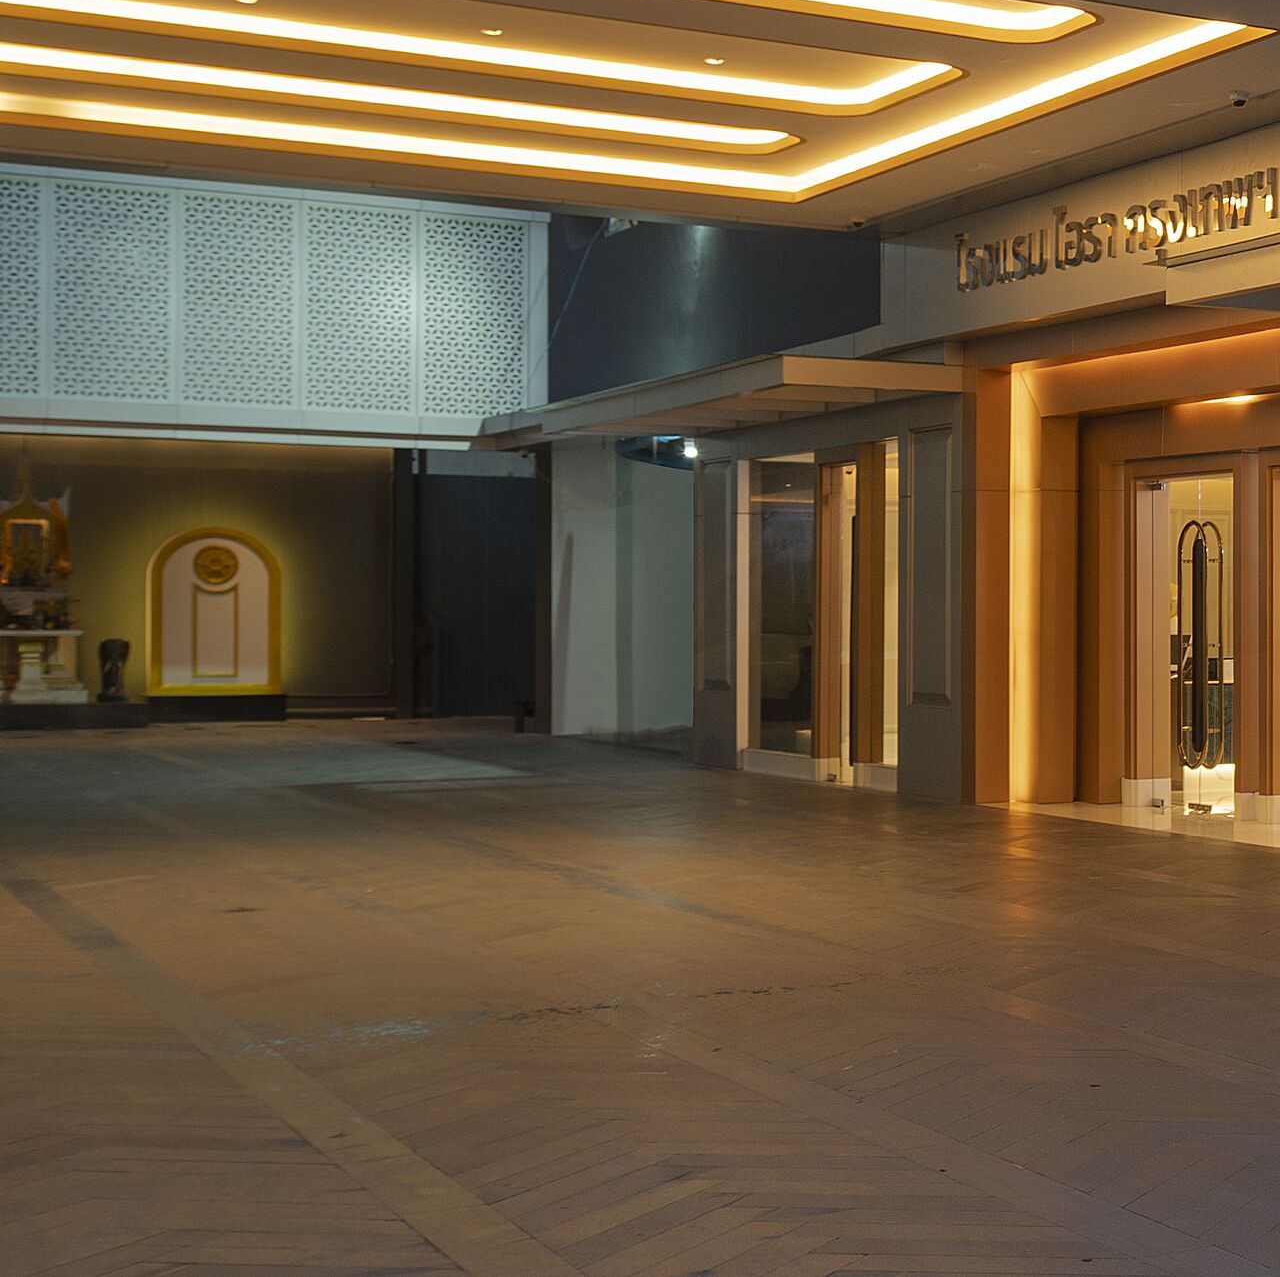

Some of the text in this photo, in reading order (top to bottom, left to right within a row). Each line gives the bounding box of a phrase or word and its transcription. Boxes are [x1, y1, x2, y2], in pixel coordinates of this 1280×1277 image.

[953, 166, 1279, 292] โรงแรม ไอรา กรุงเทพฯ
